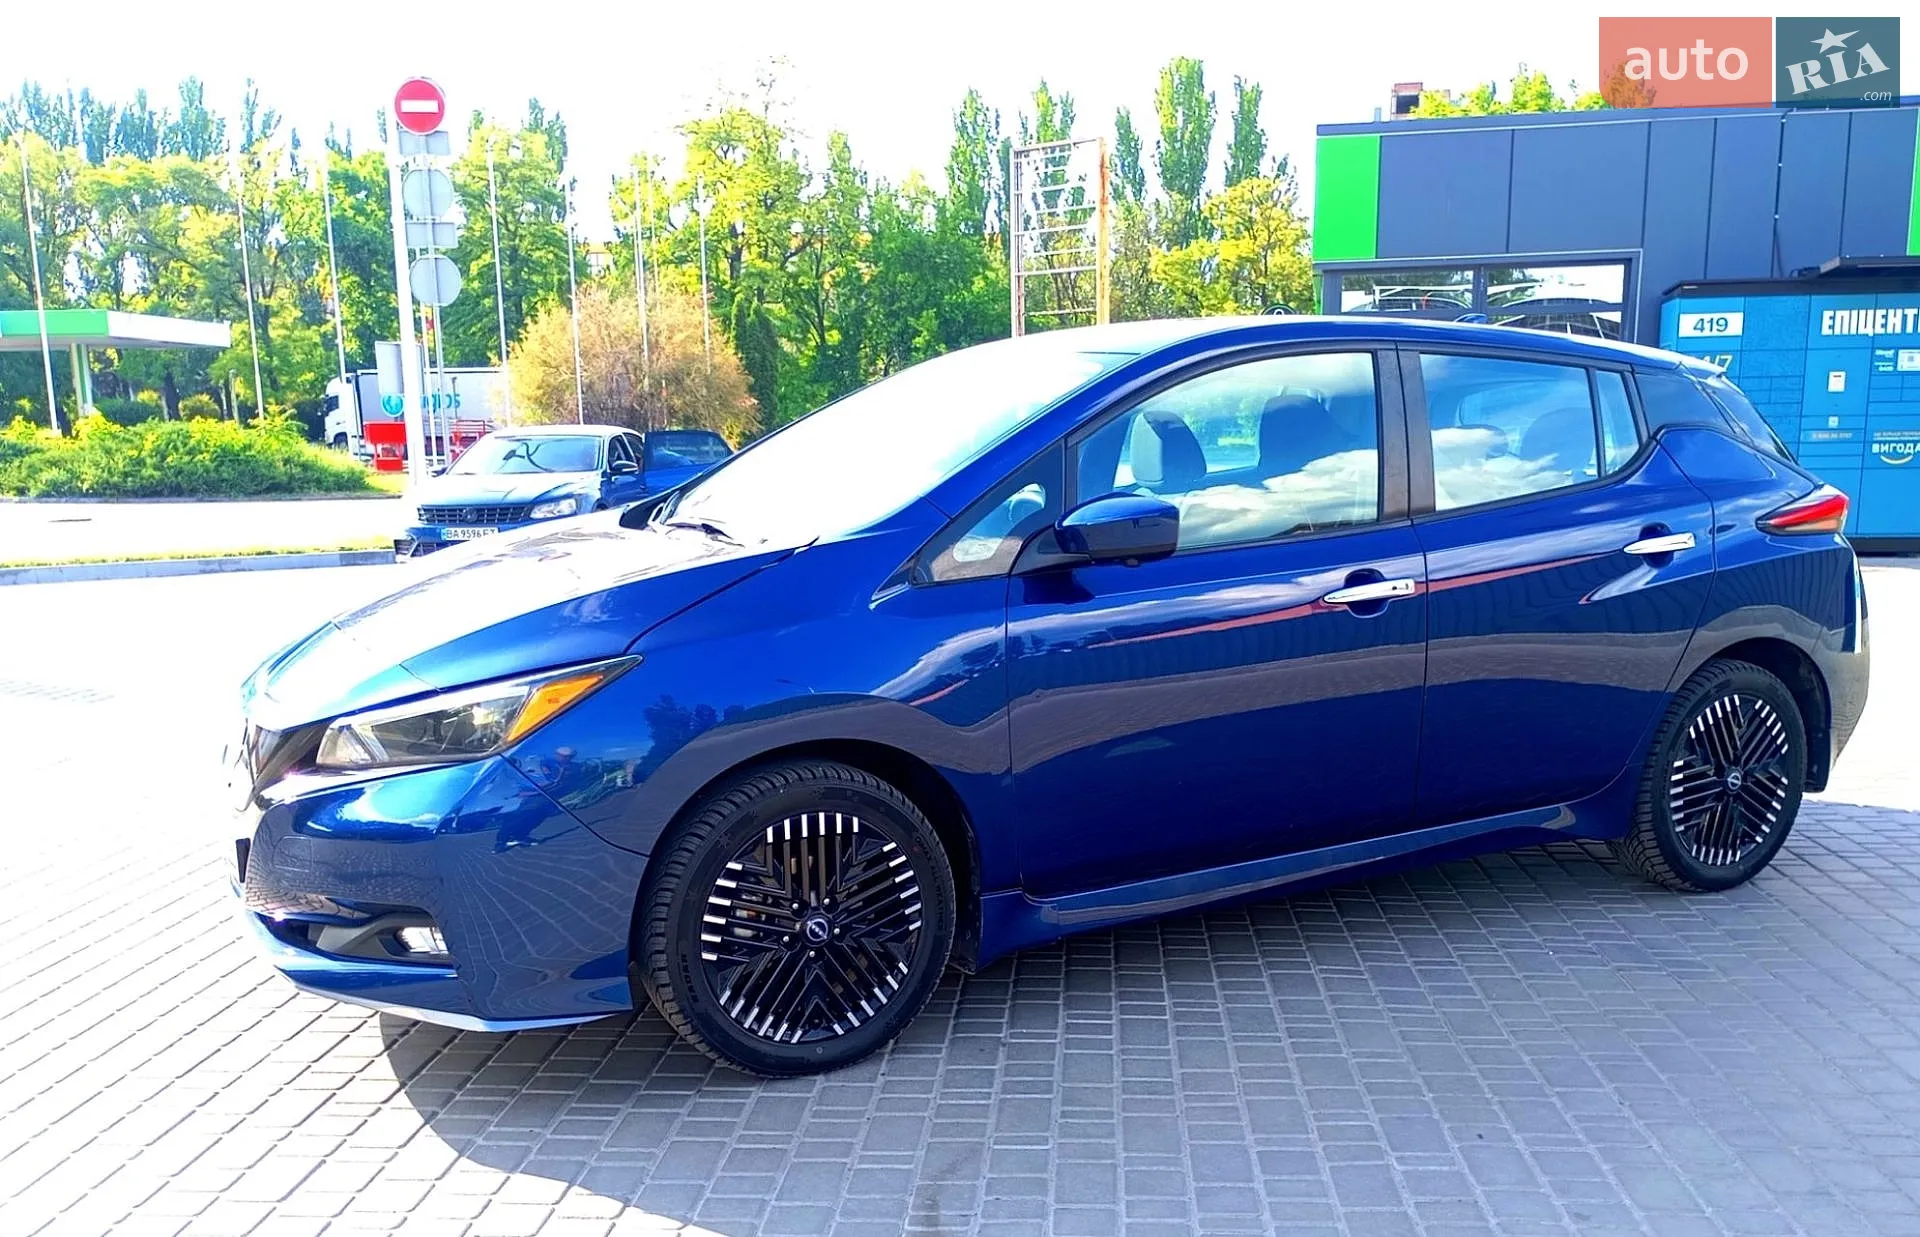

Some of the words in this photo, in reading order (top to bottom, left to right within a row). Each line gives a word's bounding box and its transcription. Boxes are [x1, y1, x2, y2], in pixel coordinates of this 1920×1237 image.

[1693, 317, 1729, 333] 419
[1821, 308, 1920, 336] ЕПІЦЕНТ
[461, 529, 482, 539] 9596
